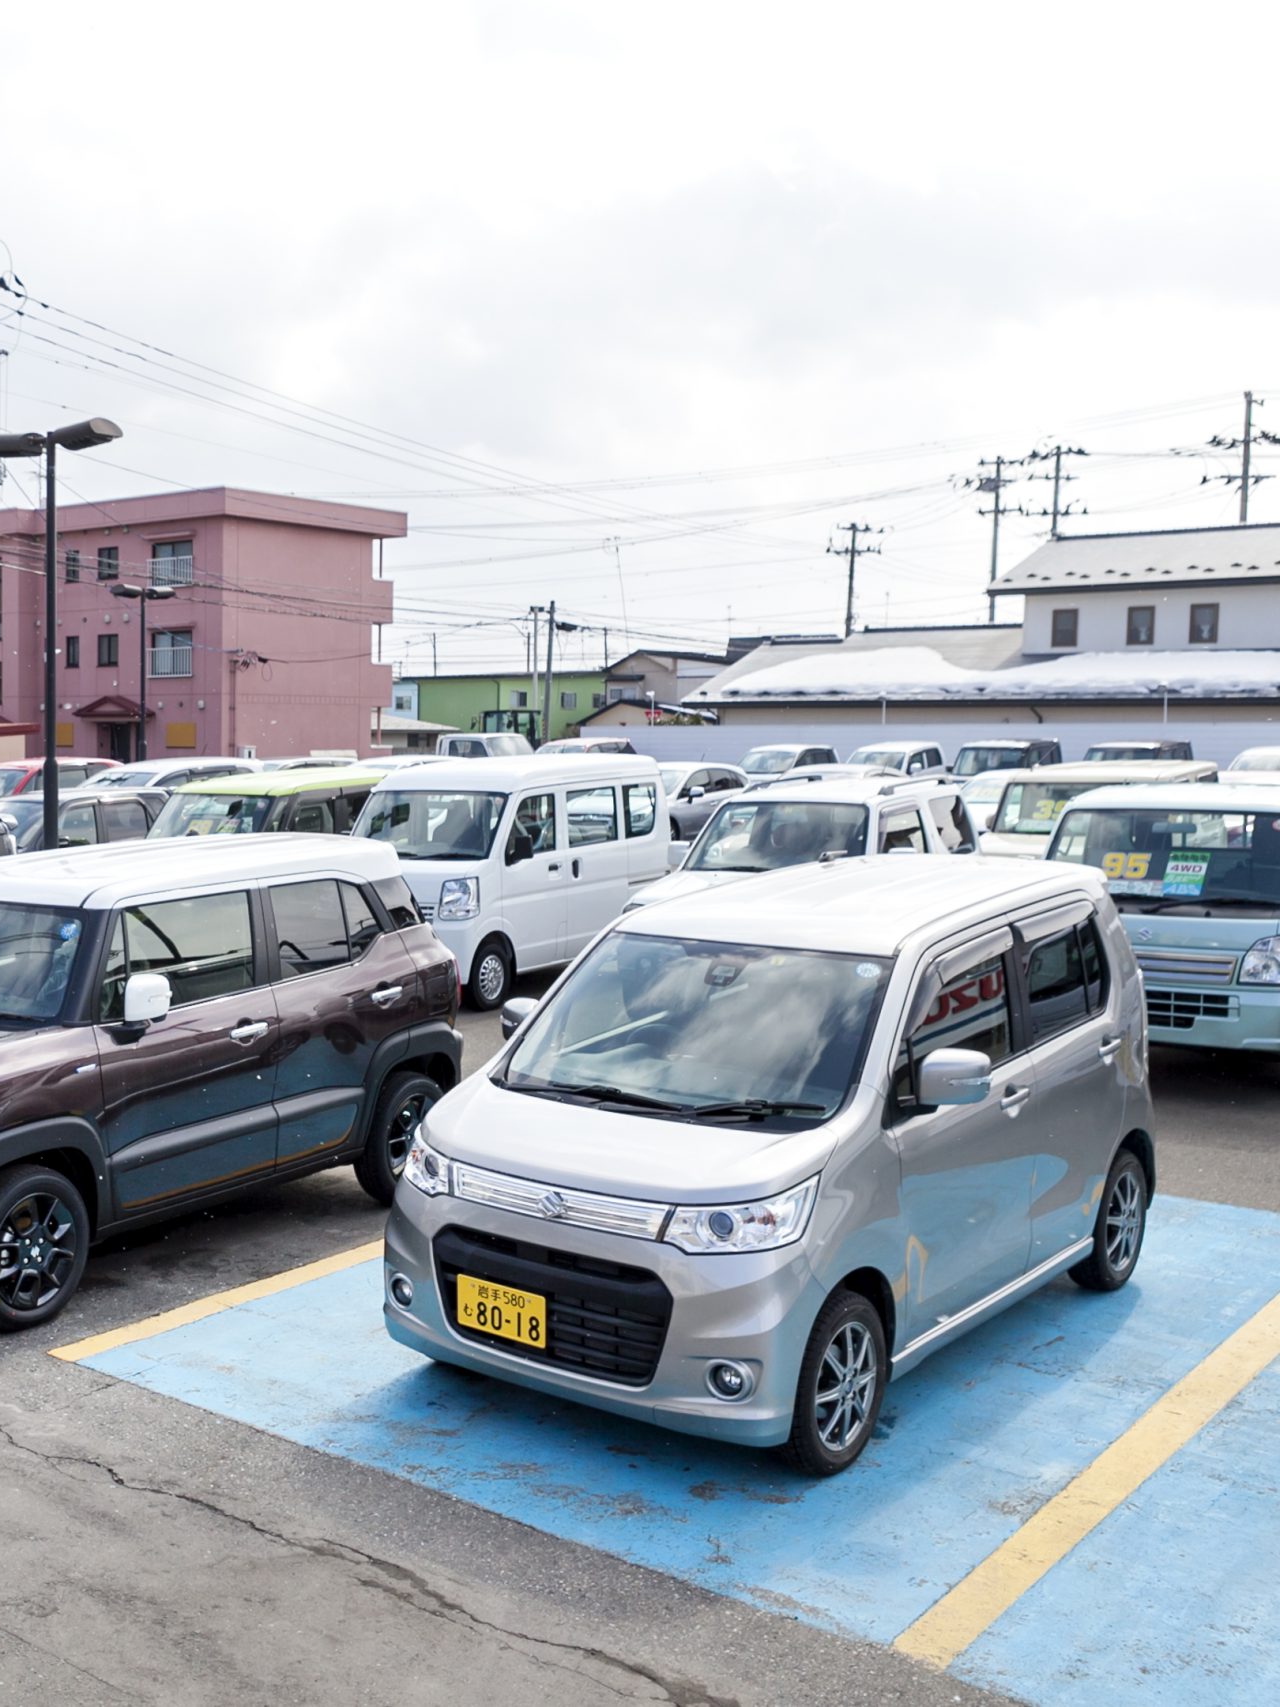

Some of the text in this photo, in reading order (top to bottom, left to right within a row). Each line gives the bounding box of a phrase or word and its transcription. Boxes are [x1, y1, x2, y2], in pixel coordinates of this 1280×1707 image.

[1102, 851, 1152, 879] 95
[1170, 863, 1203, 873] 4WD
[478, 1285, 525, 1309] 岩手580
[463, 1302, 539, 1342] む 80-18
